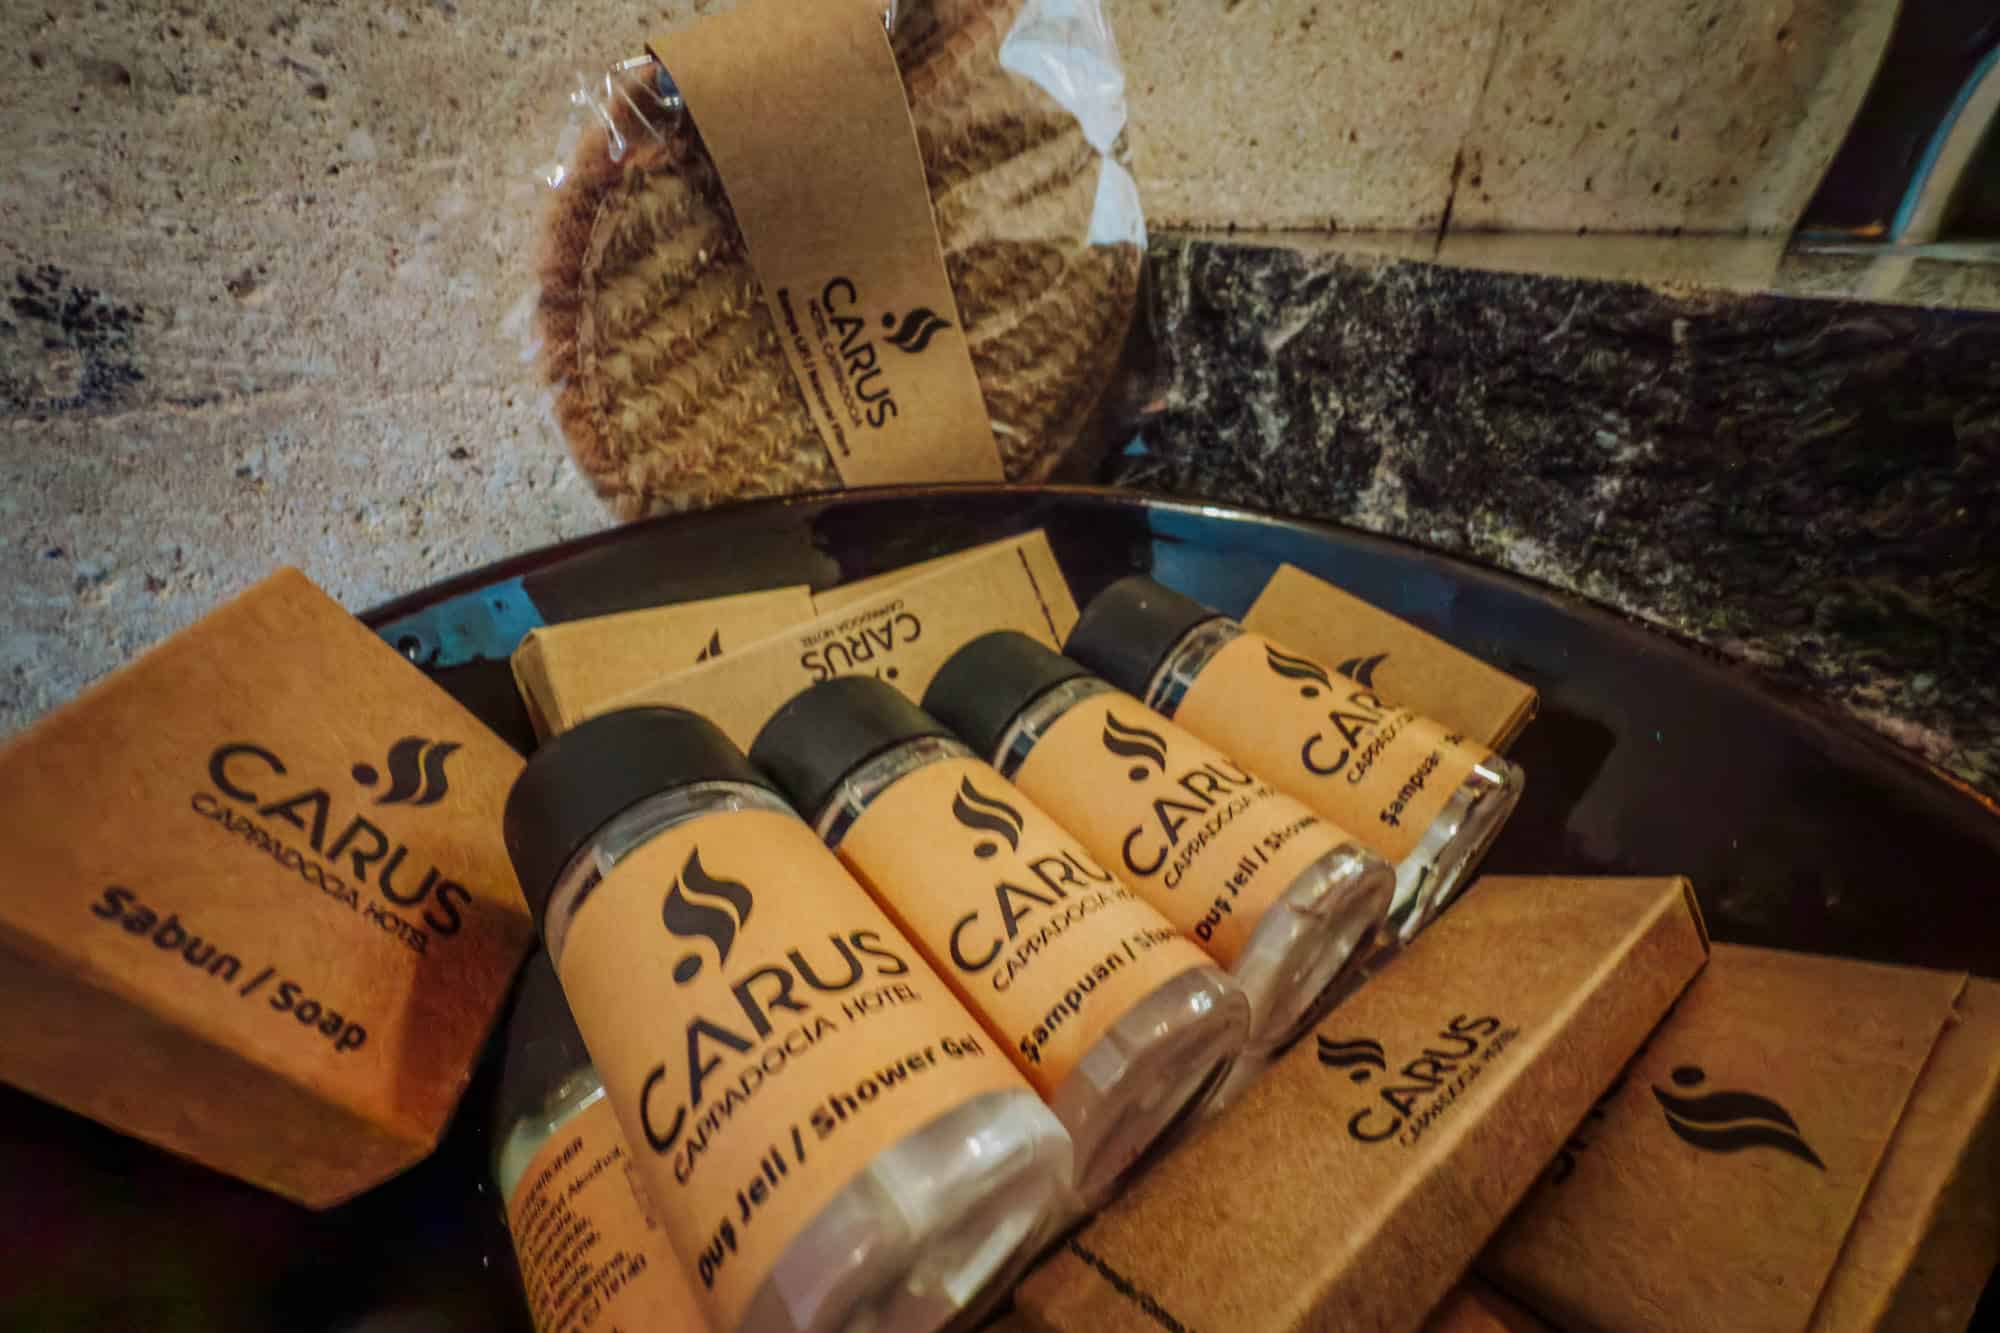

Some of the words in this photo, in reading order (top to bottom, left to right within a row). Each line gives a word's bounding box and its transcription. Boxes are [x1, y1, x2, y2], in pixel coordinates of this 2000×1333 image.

[822, 276, 898, 428] CARUS
[800, 611, 922, 682] CARUS
[1301, 688, 1400, 776] CAR
[190, 790, 360, 912] CAPPADOCIA
[362, 902, 430, 956] HOTEL
[207, 742, 473, 938] CARUS
[1122, 763, 1253, 877] CARU
[1223, 855, 1260, 897] Jell
[949, 849, 1115, 974] CARU
[239, 966, 276, 998] /
[639, 929, 911, 1154] CARUS
[1018, 950, 1126, 1064] Şampuan
[673, 1015, 839, 1187] CAPPADOCIA
[841, 980, 922, 1023] HOTEL
[1347, 1013, 1501, 1143] CARUS
[736, 1145, 789, 1226] Jell
[790, 1126, 807, 1166] /
